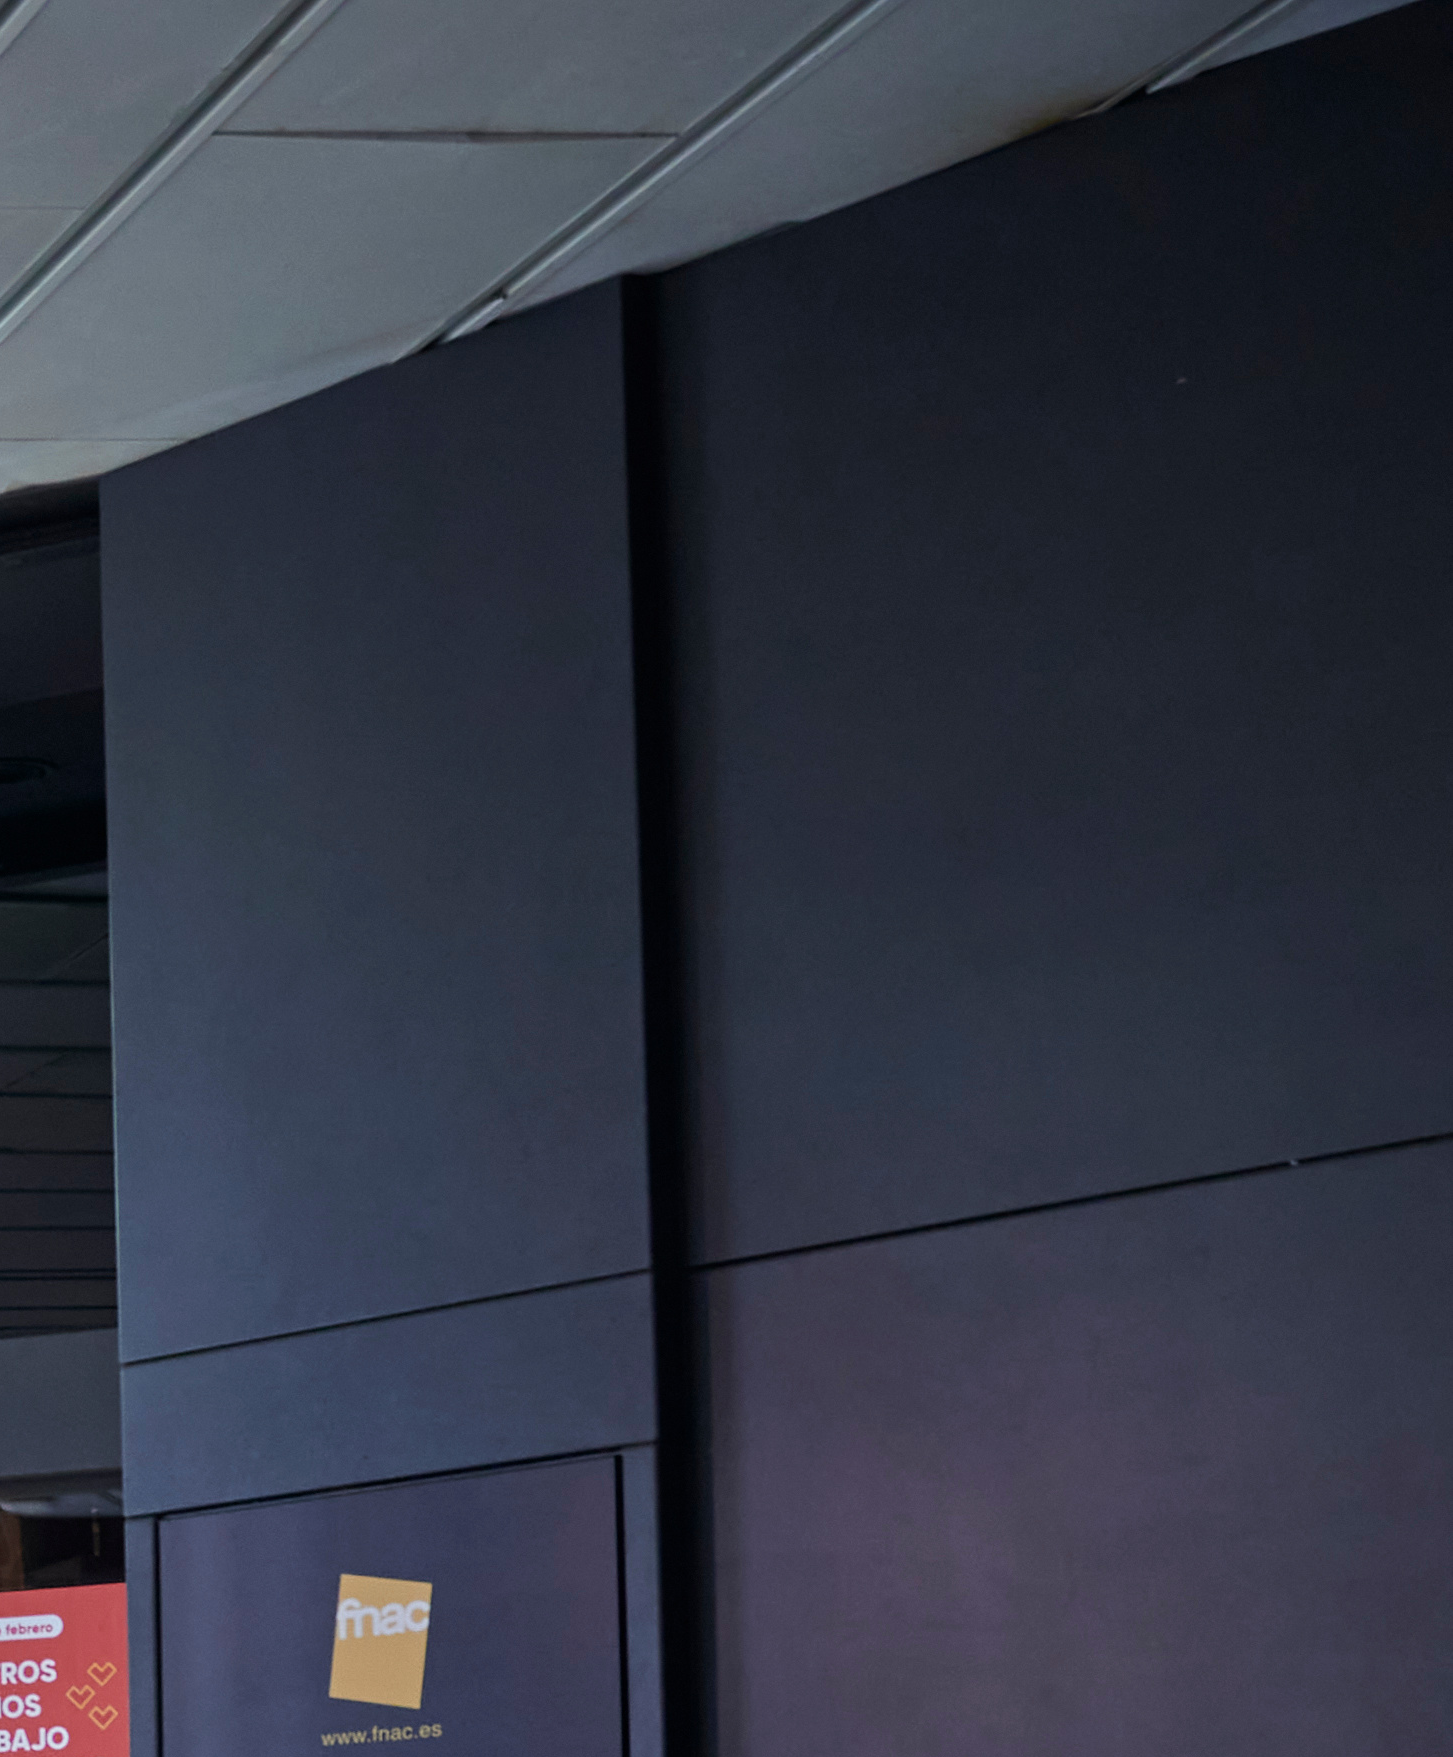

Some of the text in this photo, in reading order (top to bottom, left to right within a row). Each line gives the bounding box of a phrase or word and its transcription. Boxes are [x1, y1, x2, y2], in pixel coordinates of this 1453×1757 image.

[5, 1623, 53, 1636] febrero
[336, 1597, 430, 1640] fnac
[321, 1722, 442, 1746] www.fnac.es
